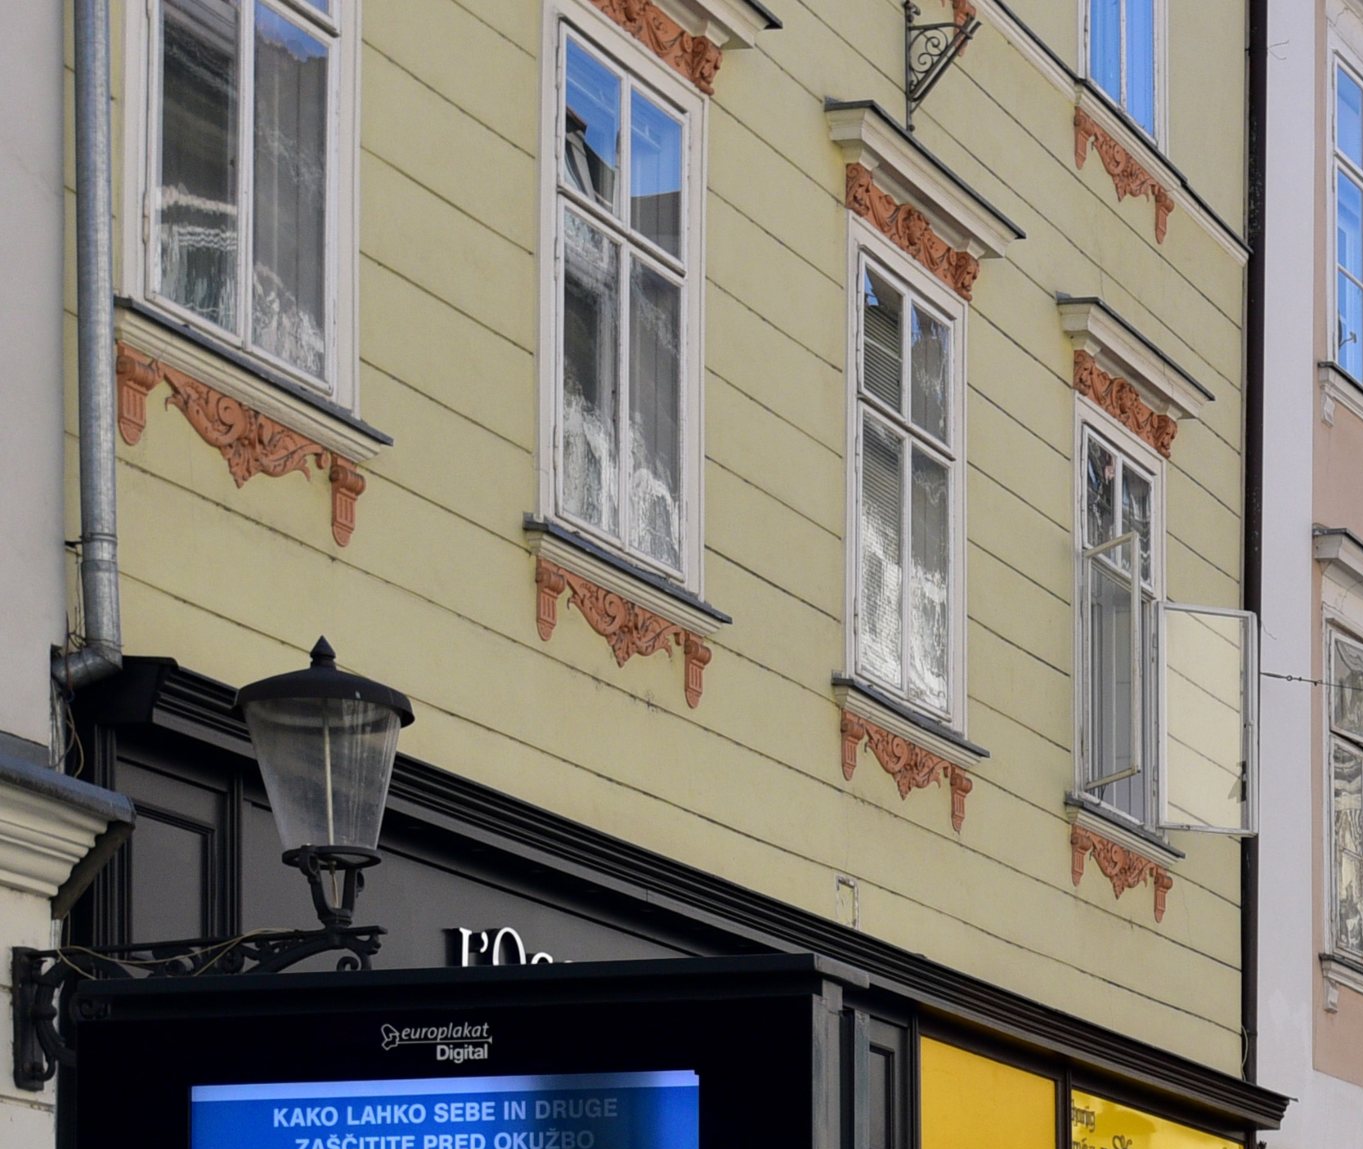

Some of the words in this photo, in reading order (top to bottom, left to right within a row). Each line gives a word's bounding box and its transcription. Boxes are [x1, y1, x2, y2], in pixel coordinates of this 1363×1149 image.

[401, 1022, 489, 1042] europlakat
[437, 1044, 488, 1064] Digital
[273, 1106, 338, 1127] KAKO
[346, 1104, 427, 1125] LAHKO
[434, 1101, 496, 1124] SEBE
[504, 1100, 526, 1121] IN
[535, 1098, 618, 1120] DRUGE
